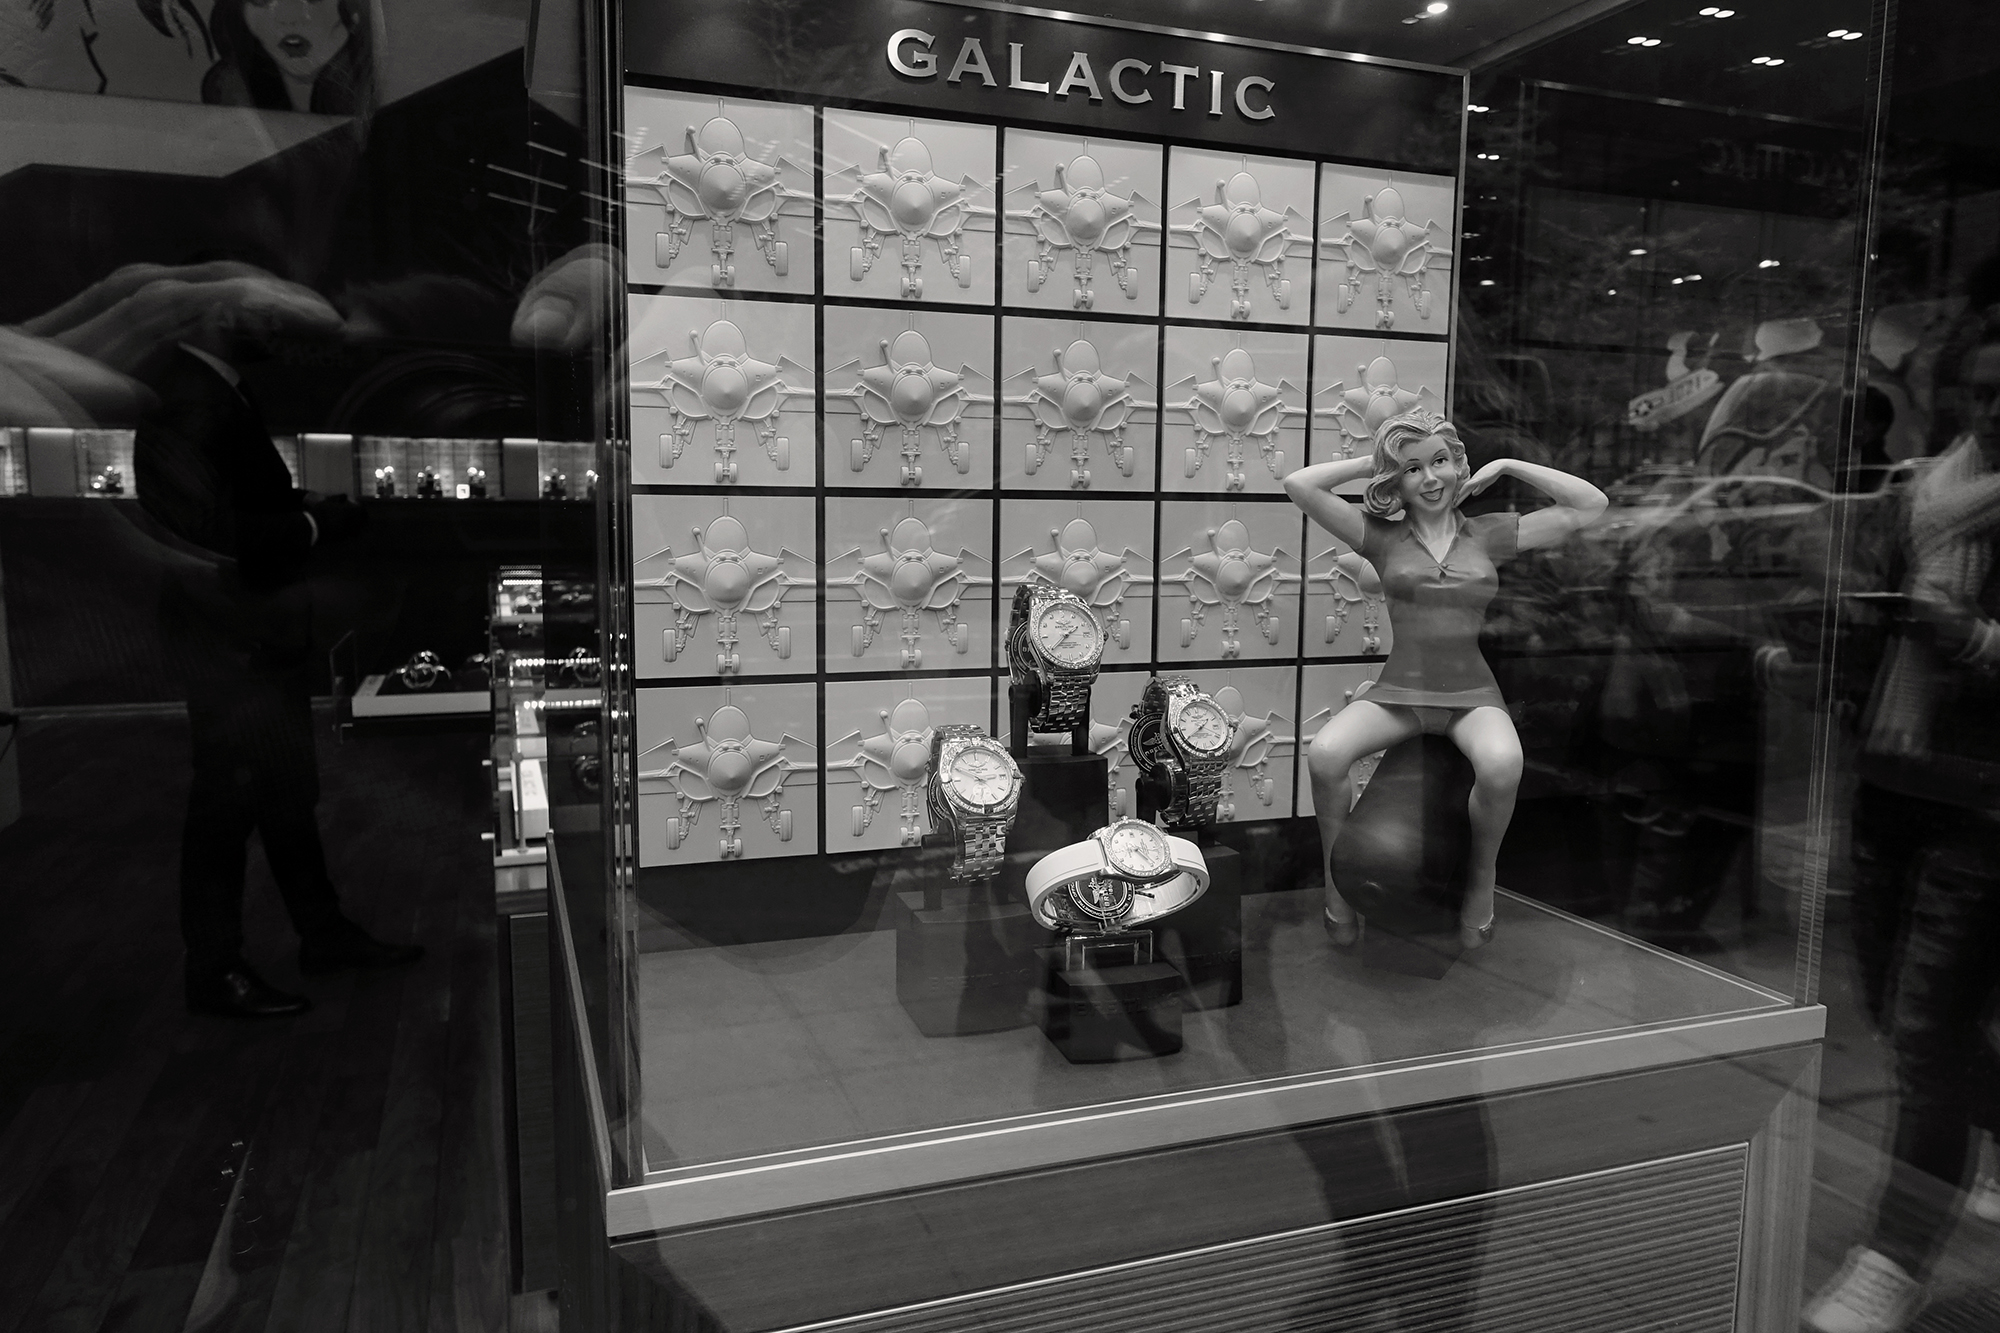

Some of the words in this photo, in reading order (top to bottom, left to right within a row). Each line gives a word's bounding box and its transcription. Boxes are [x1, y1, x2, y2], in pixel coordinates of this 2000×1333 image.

[887, 28, 1276, 121] GALACTIC
[1144, 744, 1164, 756] BREIT
[1073, 991, 1182, 1016] BREITLING
